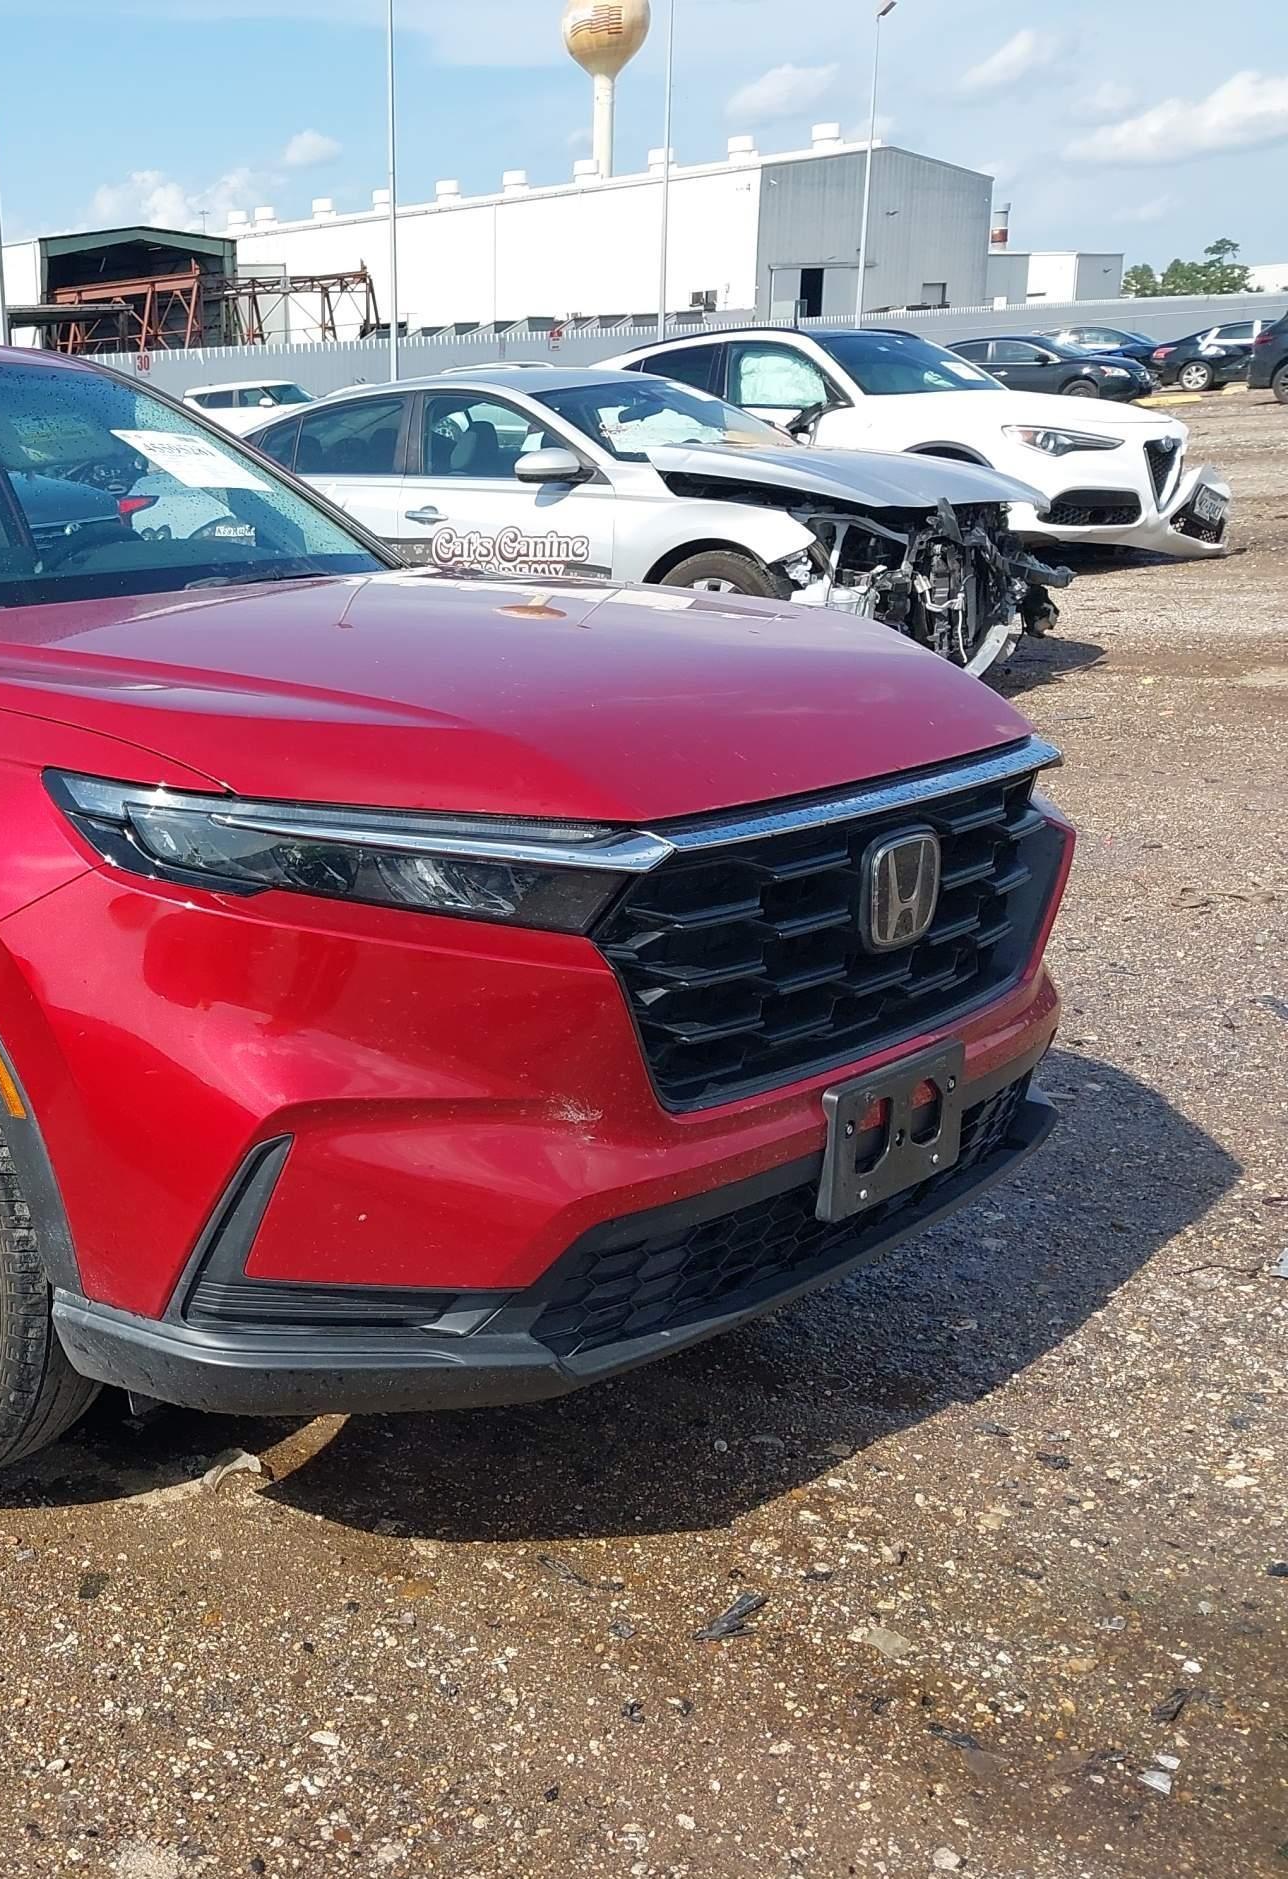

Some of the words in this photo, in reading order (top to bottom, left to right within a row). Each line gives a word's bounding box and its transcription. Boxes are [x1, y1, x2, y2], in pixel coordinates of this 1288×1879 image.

[137, 355, 150, 371] 30
[433, 528, 495, 564] Cat's
[496, 526, 590, 563] Canine
